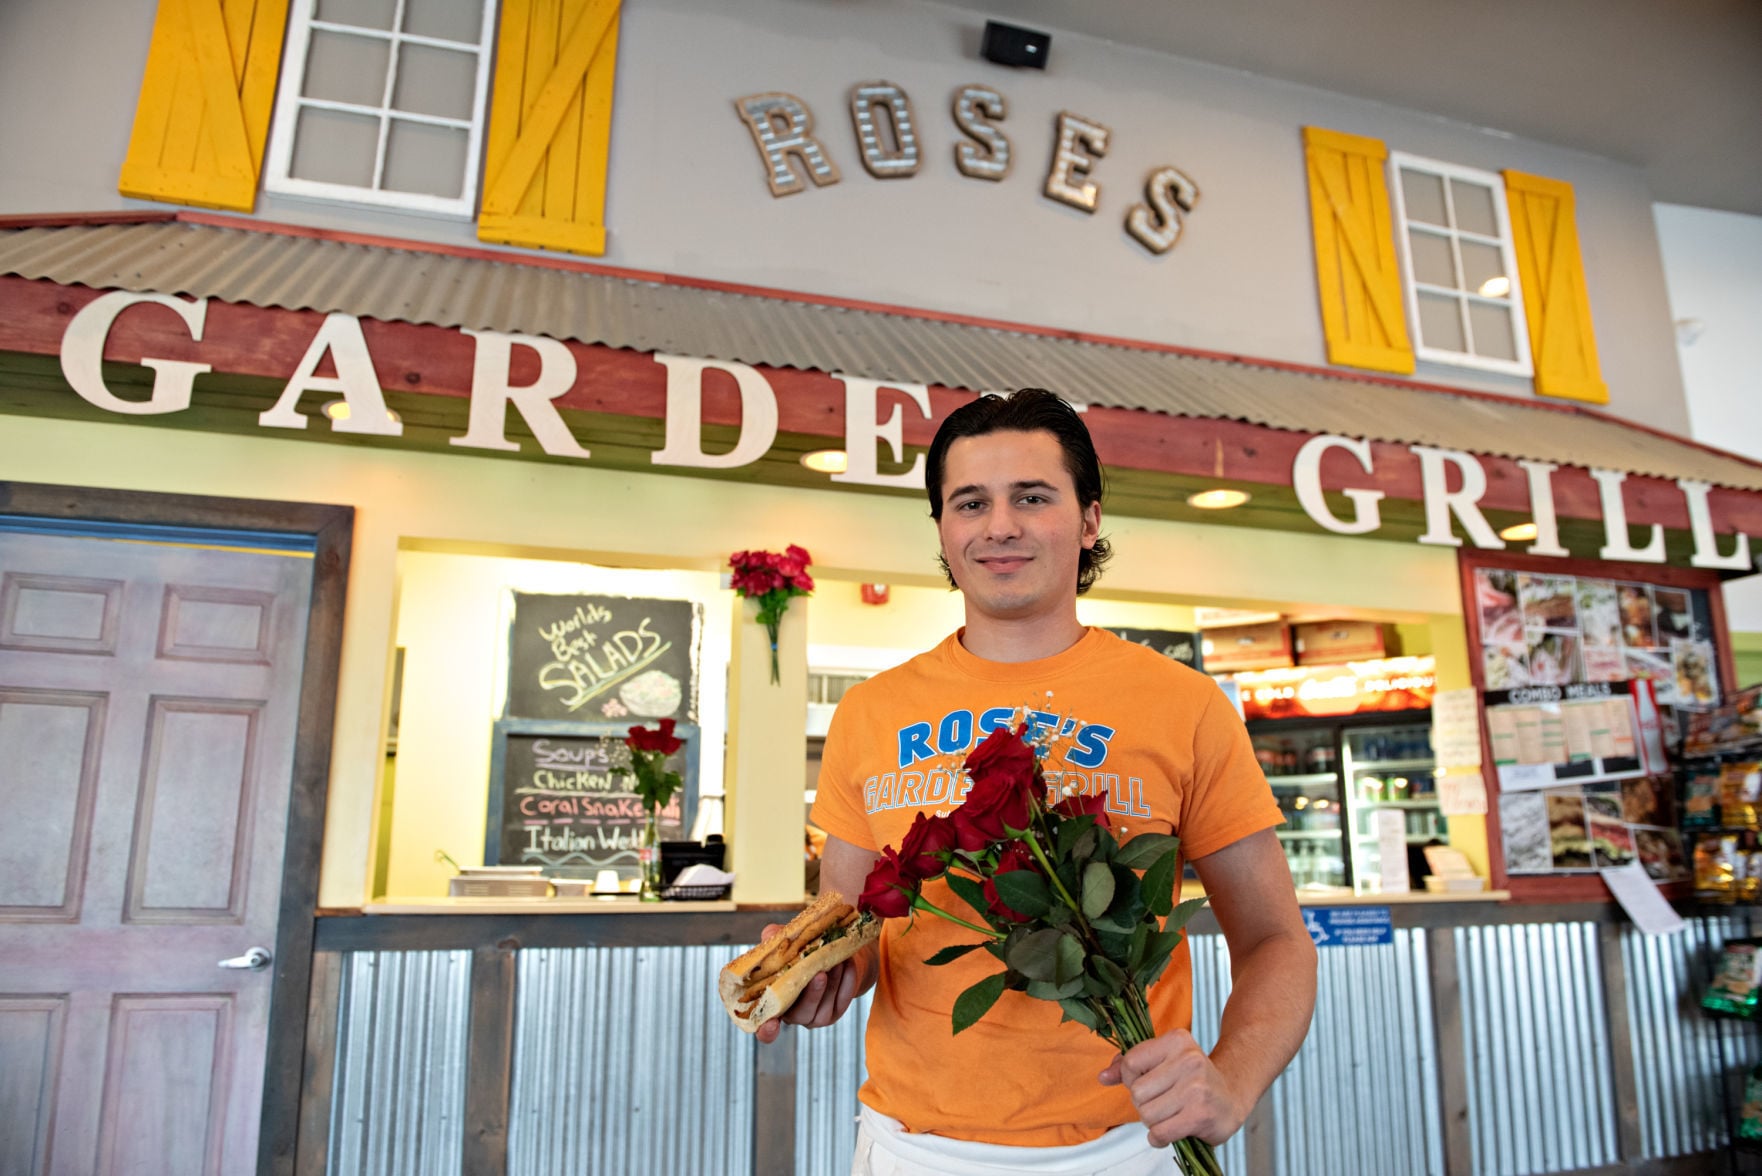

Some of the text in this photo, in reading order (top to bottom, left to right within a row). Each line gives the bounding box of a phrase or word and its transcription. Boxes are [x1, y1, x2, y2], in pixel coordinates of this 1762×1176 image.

[735, 80, 1200, 254] ROSES
[59, 290, 1752, 570] GARDE GRILL
[538, 617, 661, 706] SALADS
[552, 629, 598, 662] Best
[1508, 682, 1612, 705] COMBO MEALS
[531, 739, 610, 766] Soups
[519, 795, 578, 816] Coral
[863, 768, 975, 815] GARDE
[522, 825, 595, 853] Italian
